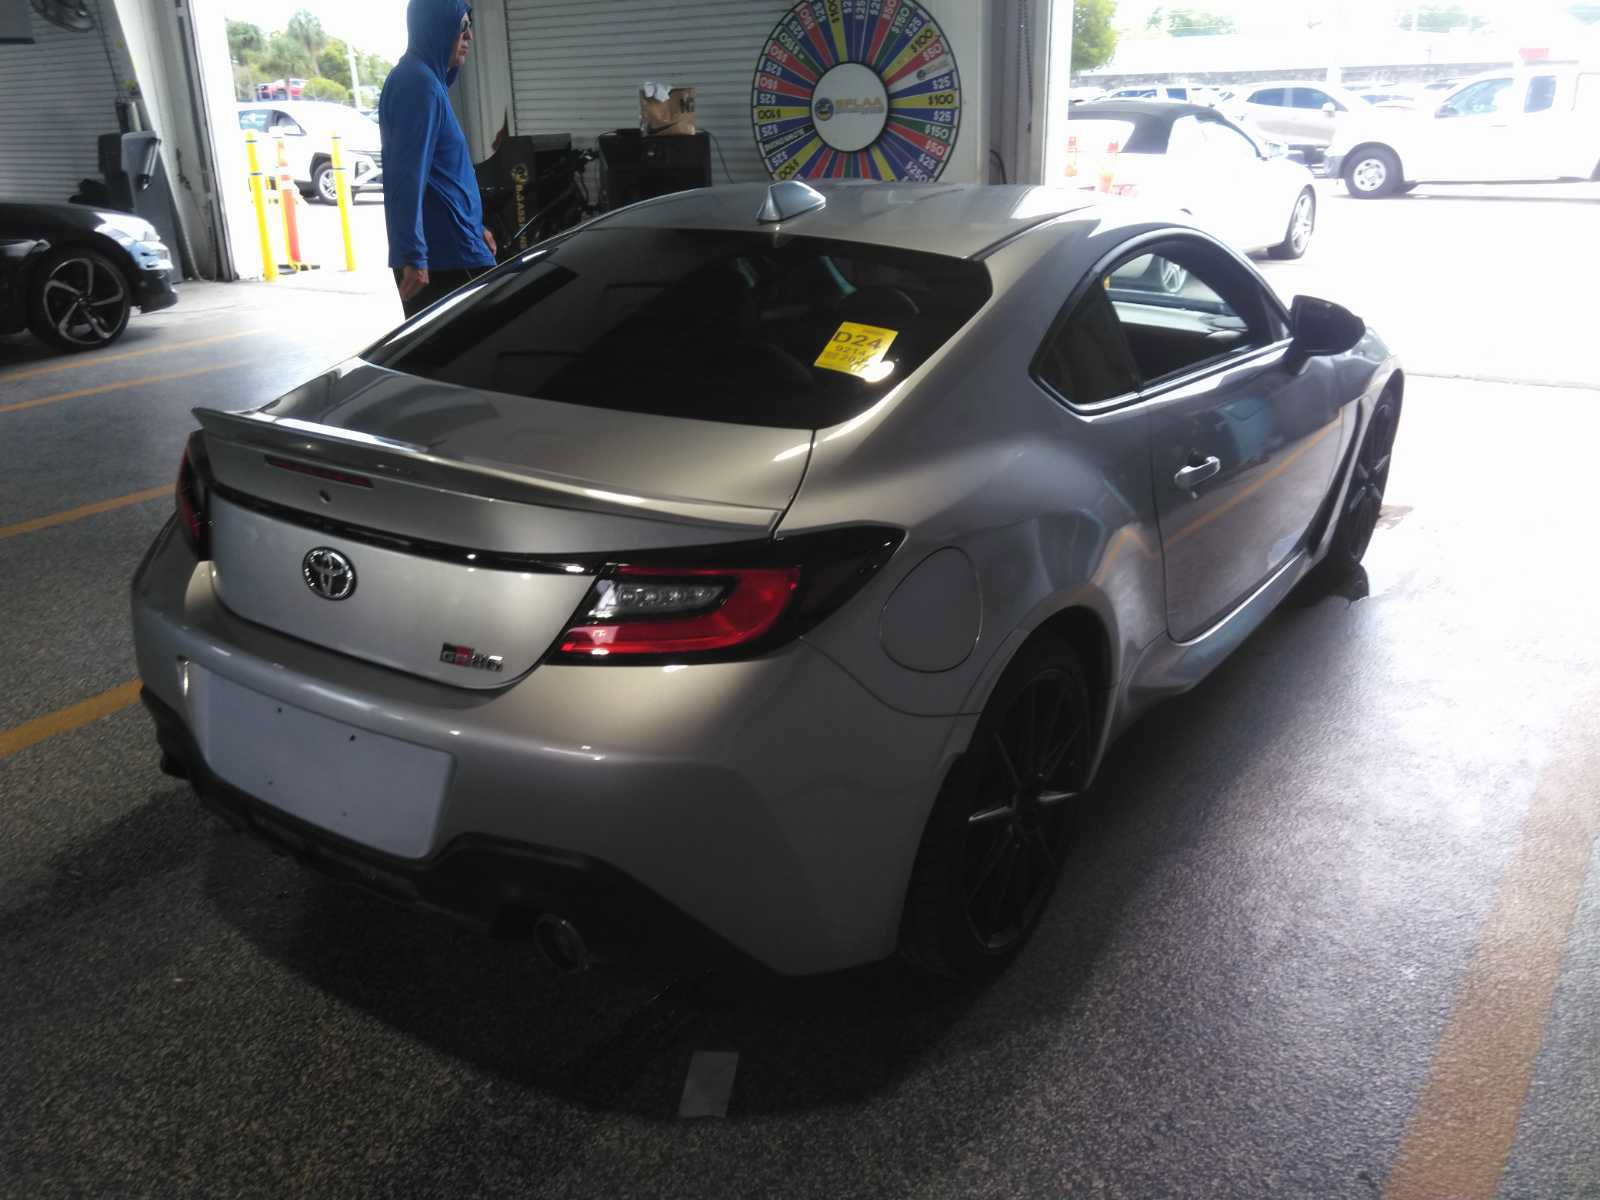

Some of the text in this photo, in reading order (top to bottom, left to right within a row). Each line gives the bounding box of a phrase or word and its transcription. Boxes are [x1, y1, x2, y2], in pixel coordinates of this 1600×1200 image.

[911, 28, 934, 53] $100
[923, 42, 942, 61] $50
[932, 75, 951, 90] $25
[928, 93, 954, 106] $100
[758, 108, 781, 120] $100
[933, 110, 952, 122] $25
[925, 124, 949, 138] $150
[926, 140, 945, 156] $50
[919, 153, 937, 169] $25
[779, 159, 800, 181] $100
[833, 331, 883, 350] D24
